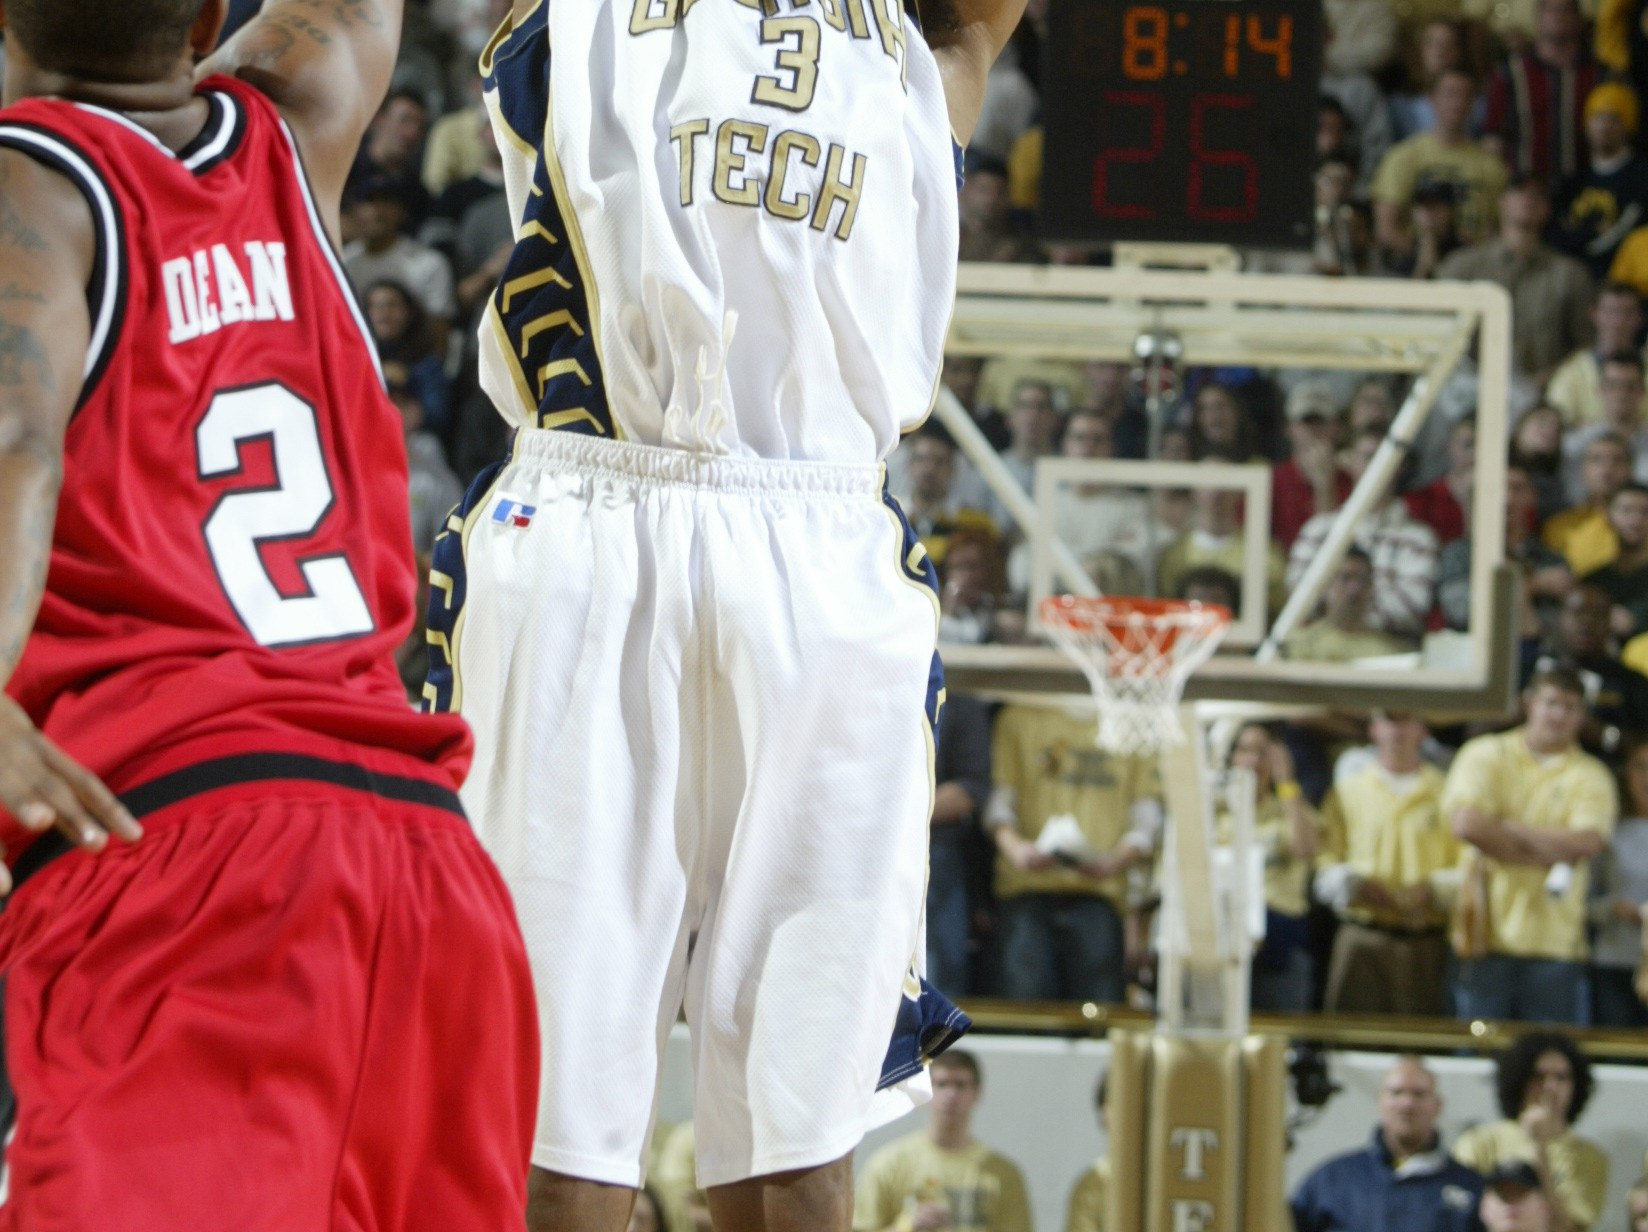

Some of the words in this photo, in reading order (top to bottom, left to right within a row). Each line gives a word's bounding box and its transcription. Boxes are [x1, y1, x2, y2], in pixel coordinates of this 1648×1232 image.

[750, 16, 821, 112] 3
[1122, 6, 1293, 81] 8:14
[670, 118, 867, 241] TECH
[1092, 90, 1259, 222] 26
[162, 241, 295, 345] DEAN
[195, 378, 378, 649] 2
